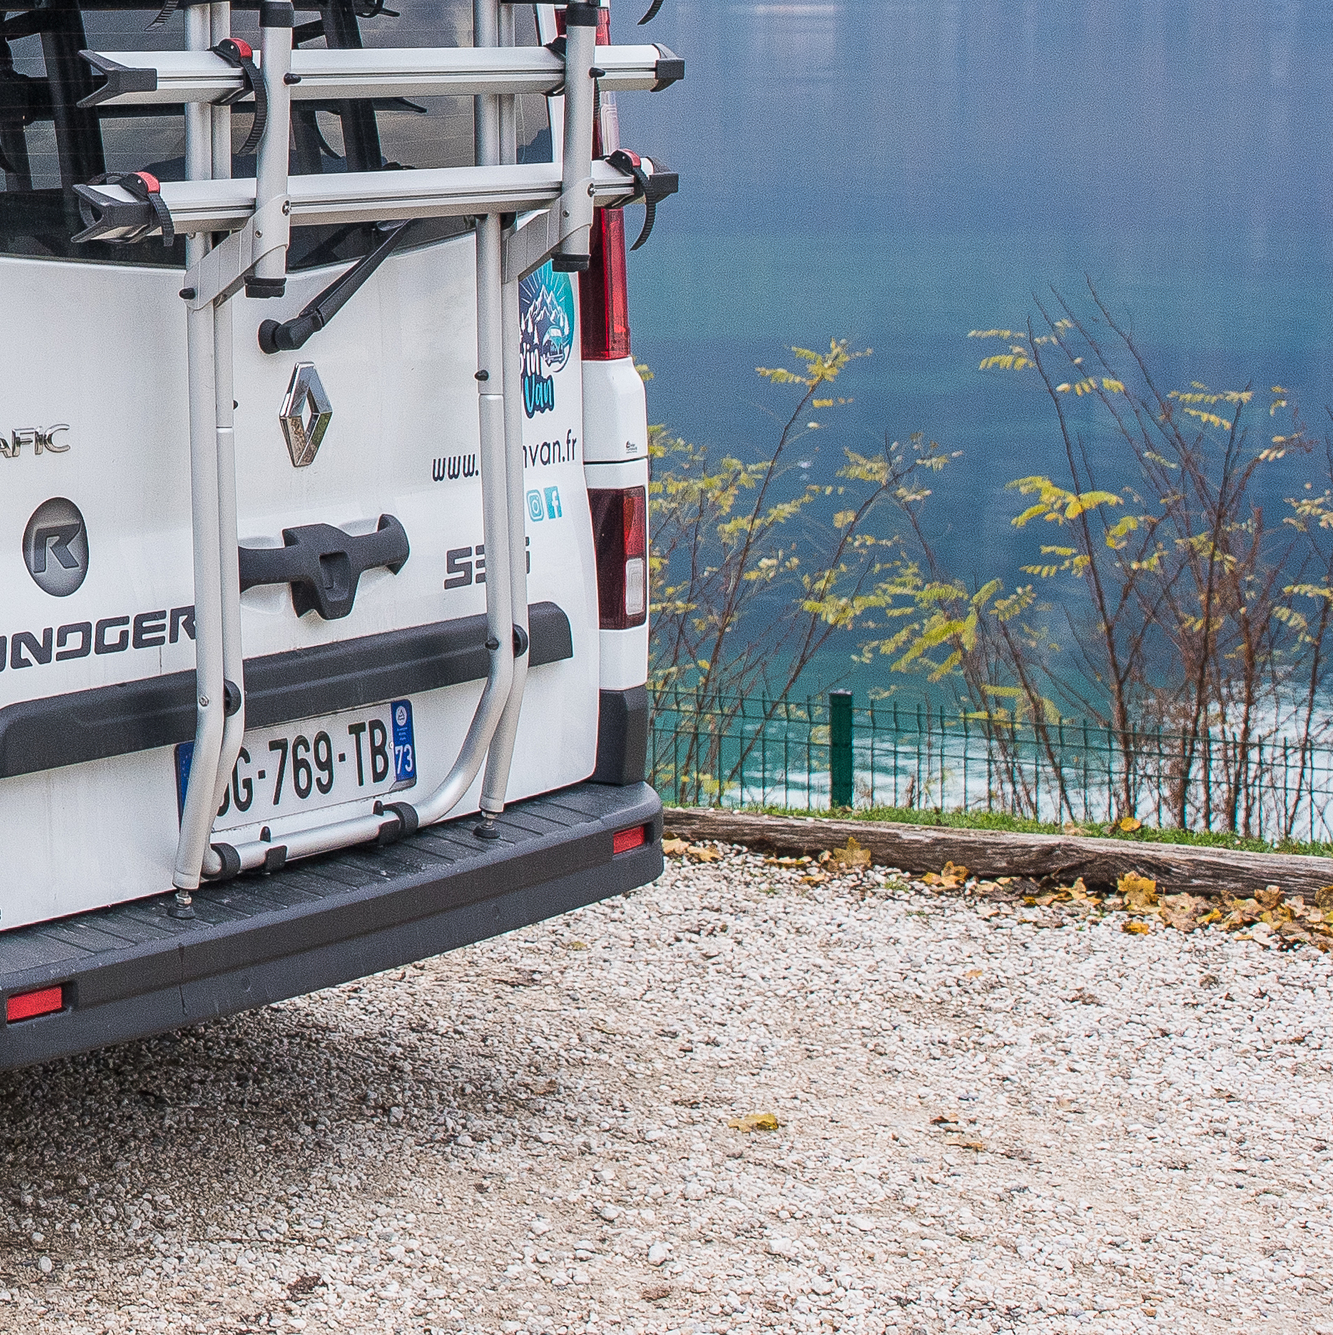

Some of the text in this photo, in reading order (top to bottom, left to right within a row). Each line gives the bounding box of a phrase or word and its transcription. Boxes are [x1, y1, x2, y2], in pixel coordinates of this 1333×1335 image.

[524, 374, 553, 414] Van
[217, 719, 413, 817] G-769-TB 73
